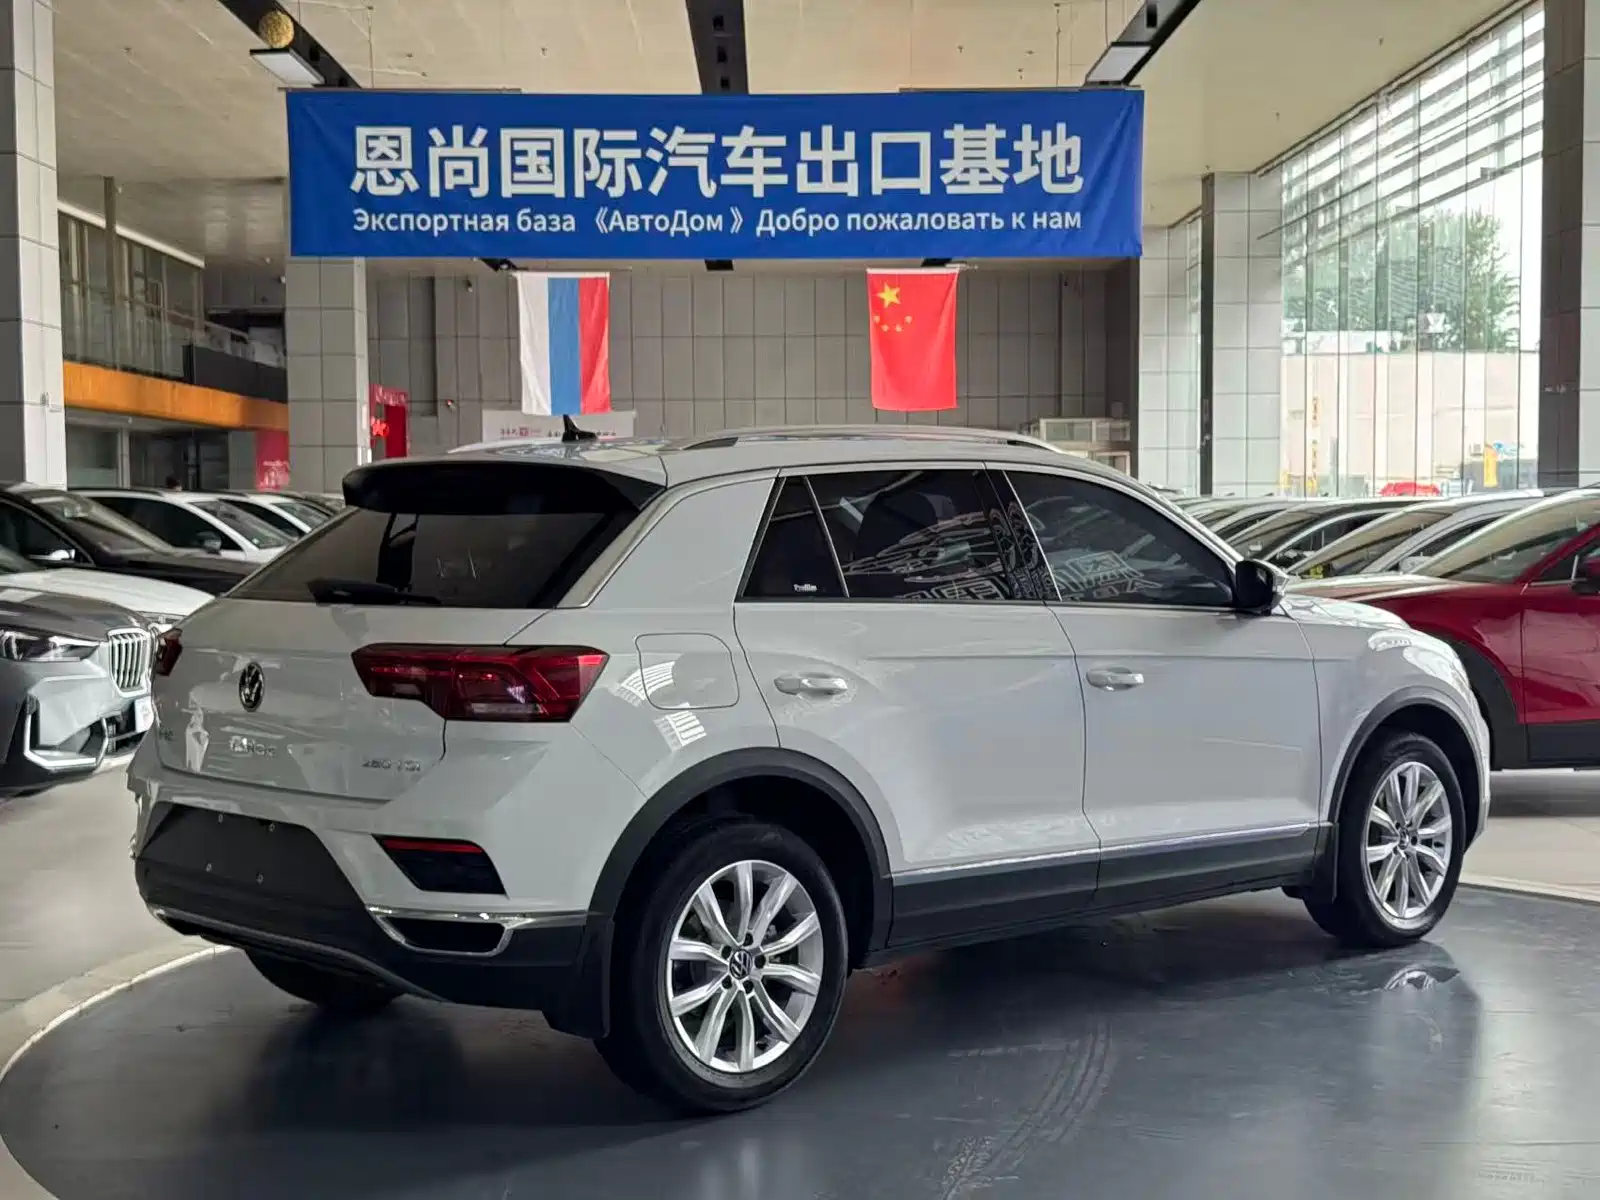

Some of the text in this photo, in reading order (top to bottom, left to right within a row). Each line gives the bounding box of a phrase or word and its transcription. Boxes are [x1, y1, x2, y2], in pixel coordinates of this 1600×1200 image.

[350, 122, 1084, 199] 恩尚国际汽车出口基地
[353, 208, 509, 237] Экспортная
[516, 208, 576, 232] база
[755, 207, 839, 237] Добро
[847, 211, 1004, 231] пожаловать
[1011, 212, 1026, 230] к
[1032, 210, 1081, 230] нам
